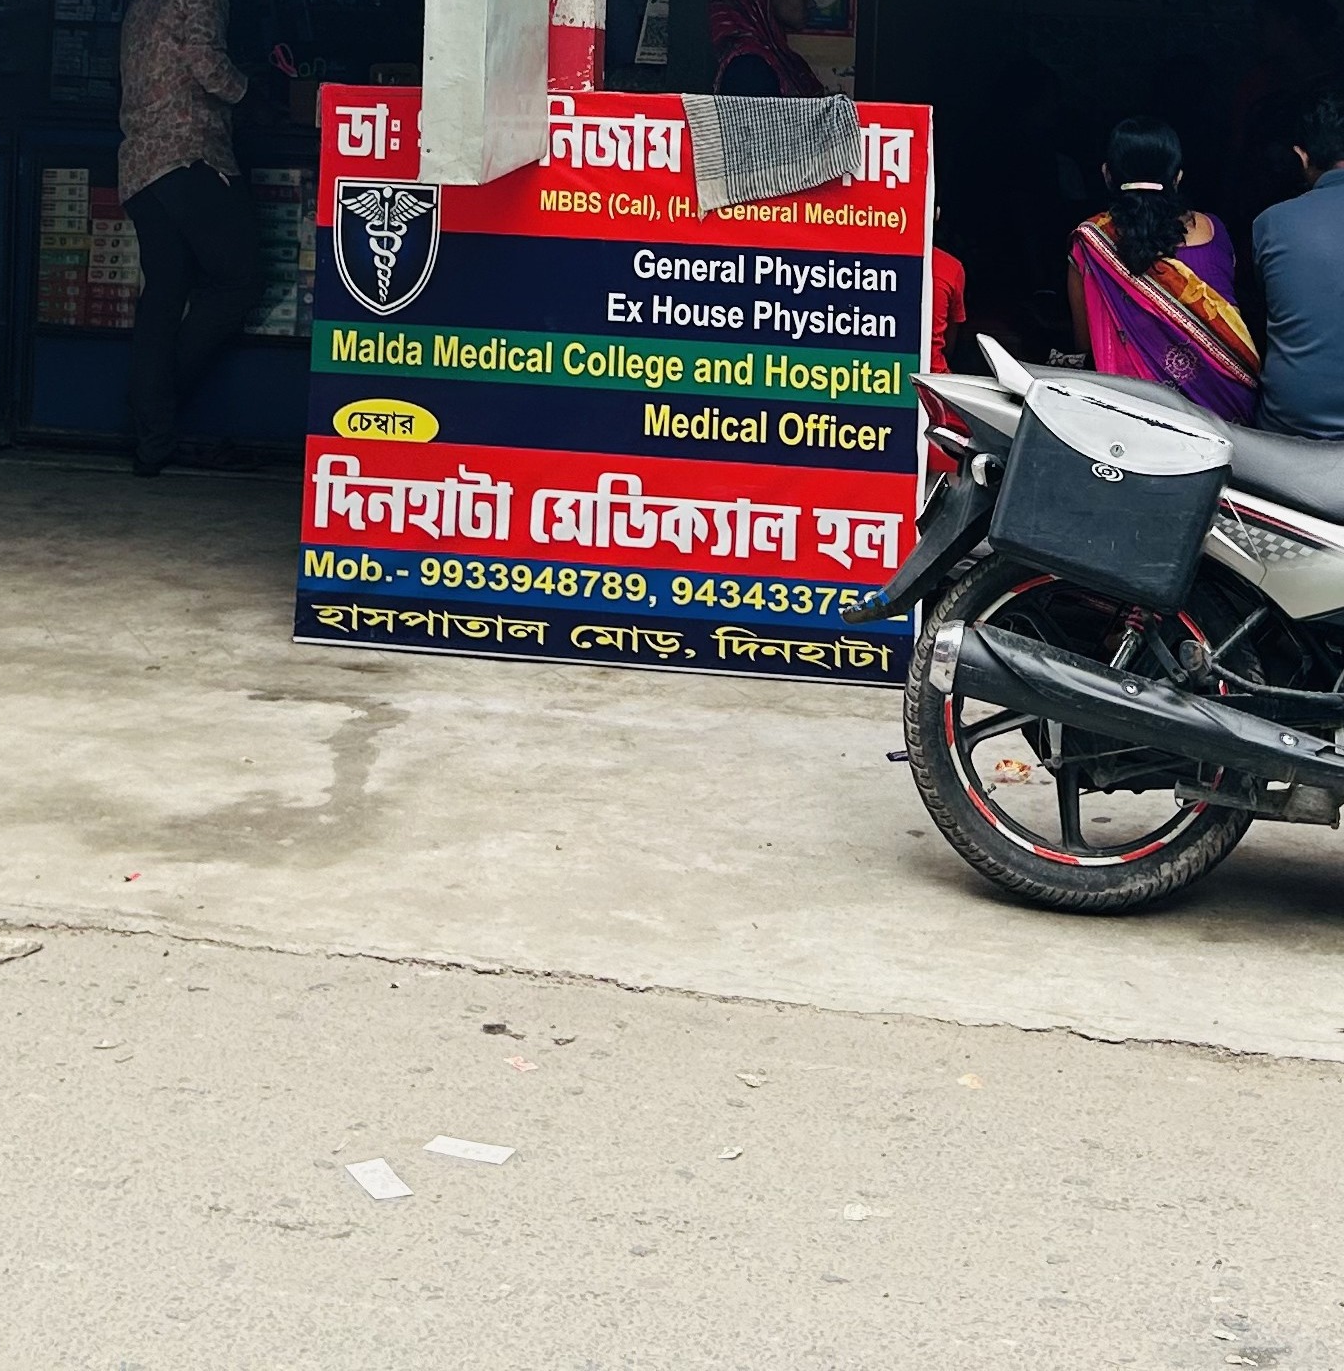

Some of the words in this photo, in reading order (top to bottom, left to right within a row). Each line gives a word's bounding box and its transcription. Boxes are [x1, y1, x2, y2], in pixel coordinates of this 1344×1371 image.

[540, 191, 603, 214] MBBS
[608, 192, 660, 220] (Cal),
[634, 249, 747, 284] General
[754, 254, 898, 297] Physician
[347, 412, 414, 436] চেম্বার
[644, 404, 767, 444] Medical
[777, 410, 891, 452] Officer
[313, 453, 513, 541] দিনহাটা
[531, 473, 801, 562] মেডিক্যাল
[814, 507, 903, 571] হল
[303, 549, 410, 584] Mob.-
[420, 557, 657, 607] 9933948789,
[312, 602, 549, 646] হাসপাতাল
[570, 624, 698, 662] মোড়,
[712, 627, 896, 673] দিনহাটা
